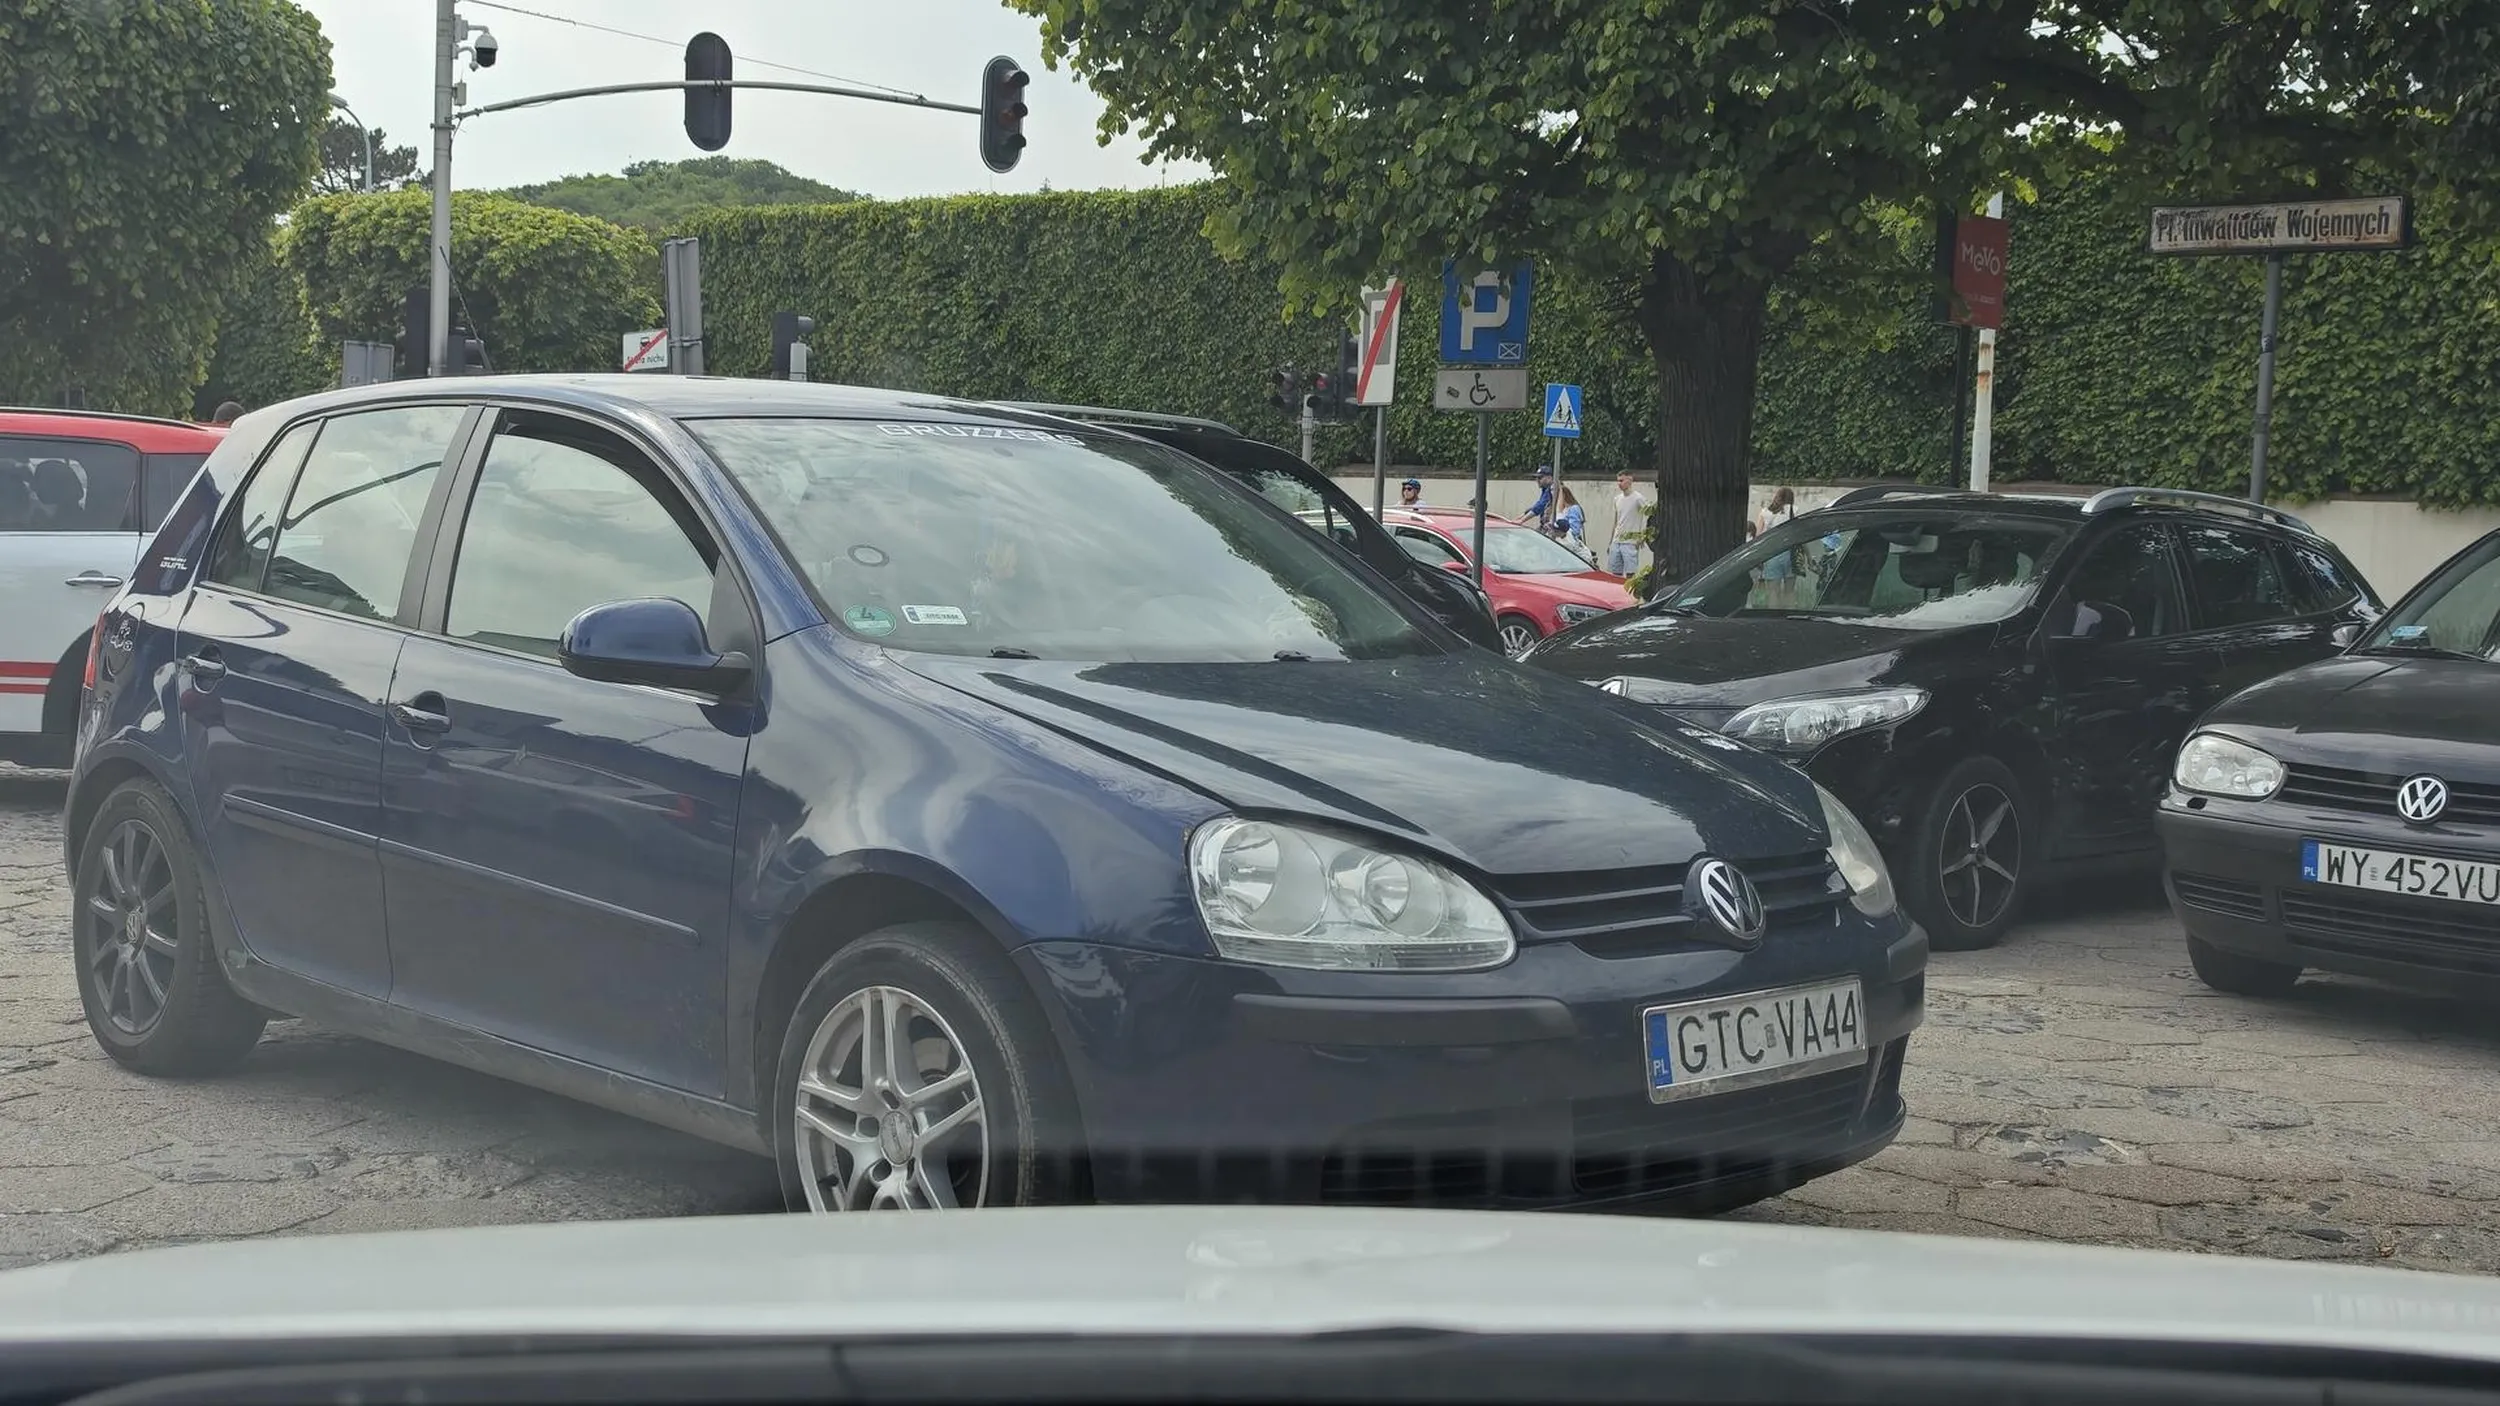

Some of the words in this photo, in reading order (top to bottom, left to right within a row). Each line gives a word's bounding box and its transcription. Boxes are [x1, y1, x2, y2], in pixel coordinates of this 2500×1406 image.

[2287, 205, 2390, 242] Wojennych
[1460, 270, 1511, 351] P
[2304, 866, 2316, 877] PL
[2326, 848, 2370, 886] WY
[2384, 857, 2500, 902] 452VU
[1677, 1006, 1765, 1074] GTC
[1775, 990, 1858, 1058] VA44
[1652, 1059, 1670, 1076] PL
